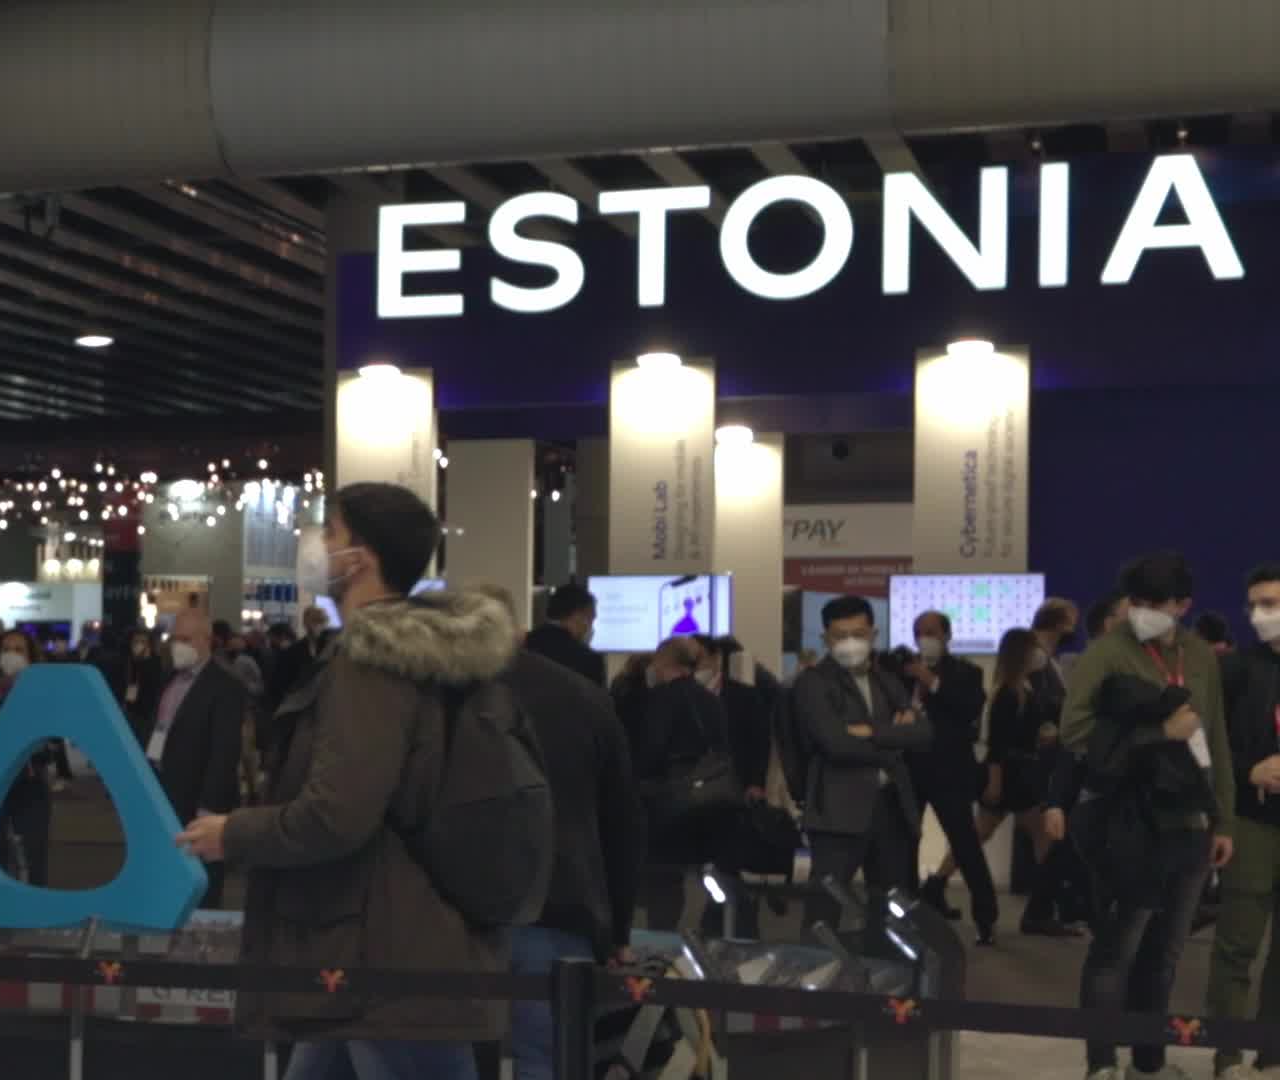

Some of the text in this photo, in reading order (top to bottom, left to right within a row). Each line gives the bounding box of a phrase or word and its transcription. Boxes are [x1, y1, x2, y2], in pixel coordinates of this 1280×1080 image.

[375, 153, 1246, 320] ESTONIA
[652, 481, 667, 560] Mobi Lab
[784, 517, 845, 544] PAY
[959, 449, 979, 559] Cybernetica
